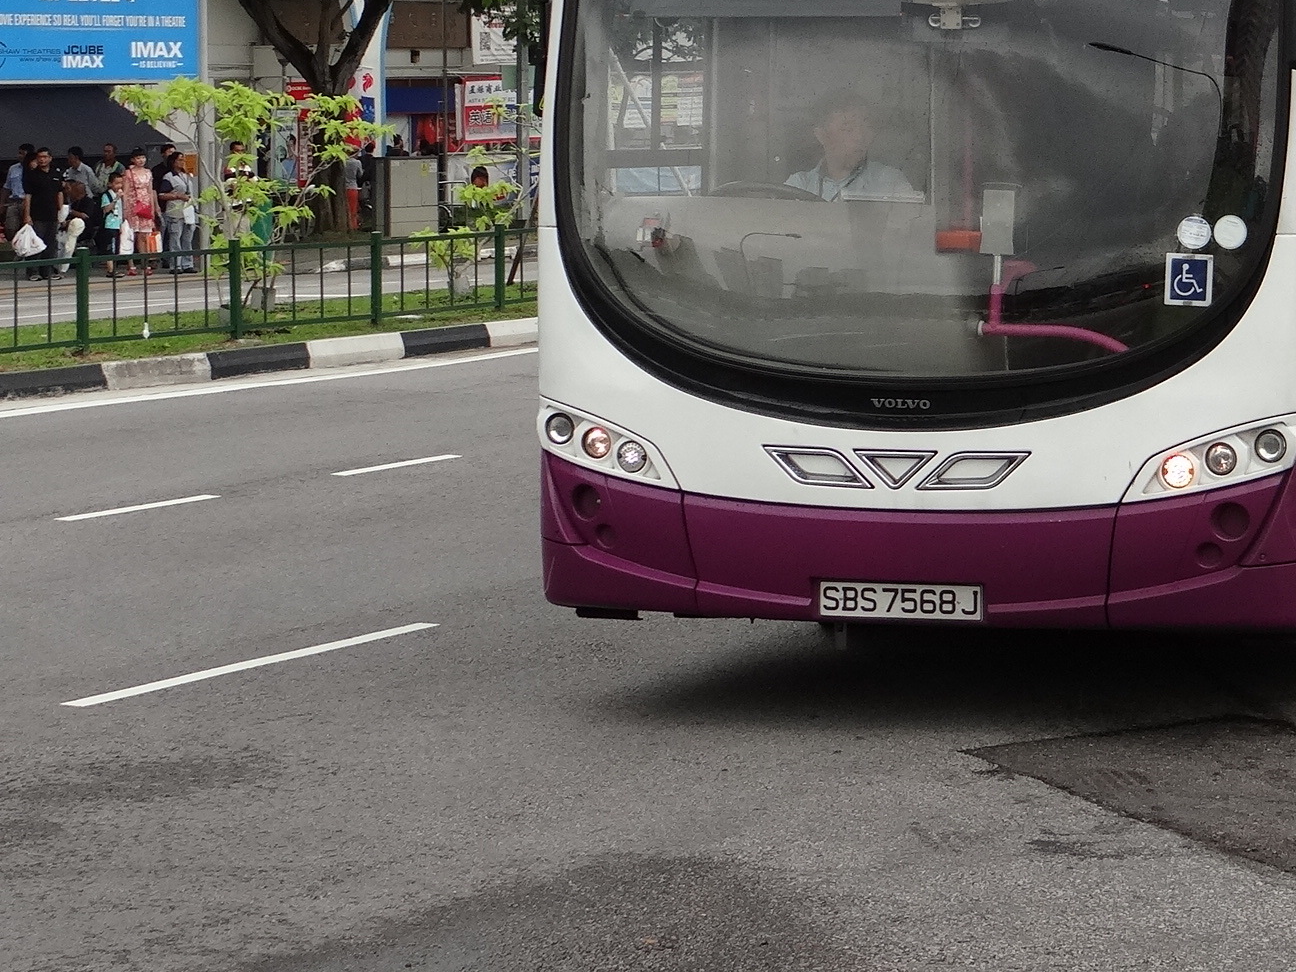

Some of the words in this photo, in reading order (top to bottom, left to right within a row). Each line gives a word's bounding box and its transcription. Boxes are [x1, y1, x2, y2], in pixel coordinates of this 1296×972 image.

[14, 13, 52, 26] EXPERIENCE
[62, 15, 79, 27] REAL
[63, 45, 104, 55] JCUBE
[130, 41, 184, 58] IMAX
[61, 55, 105, 69] IMAX
[870, 398, 931, 409] VOLVO
